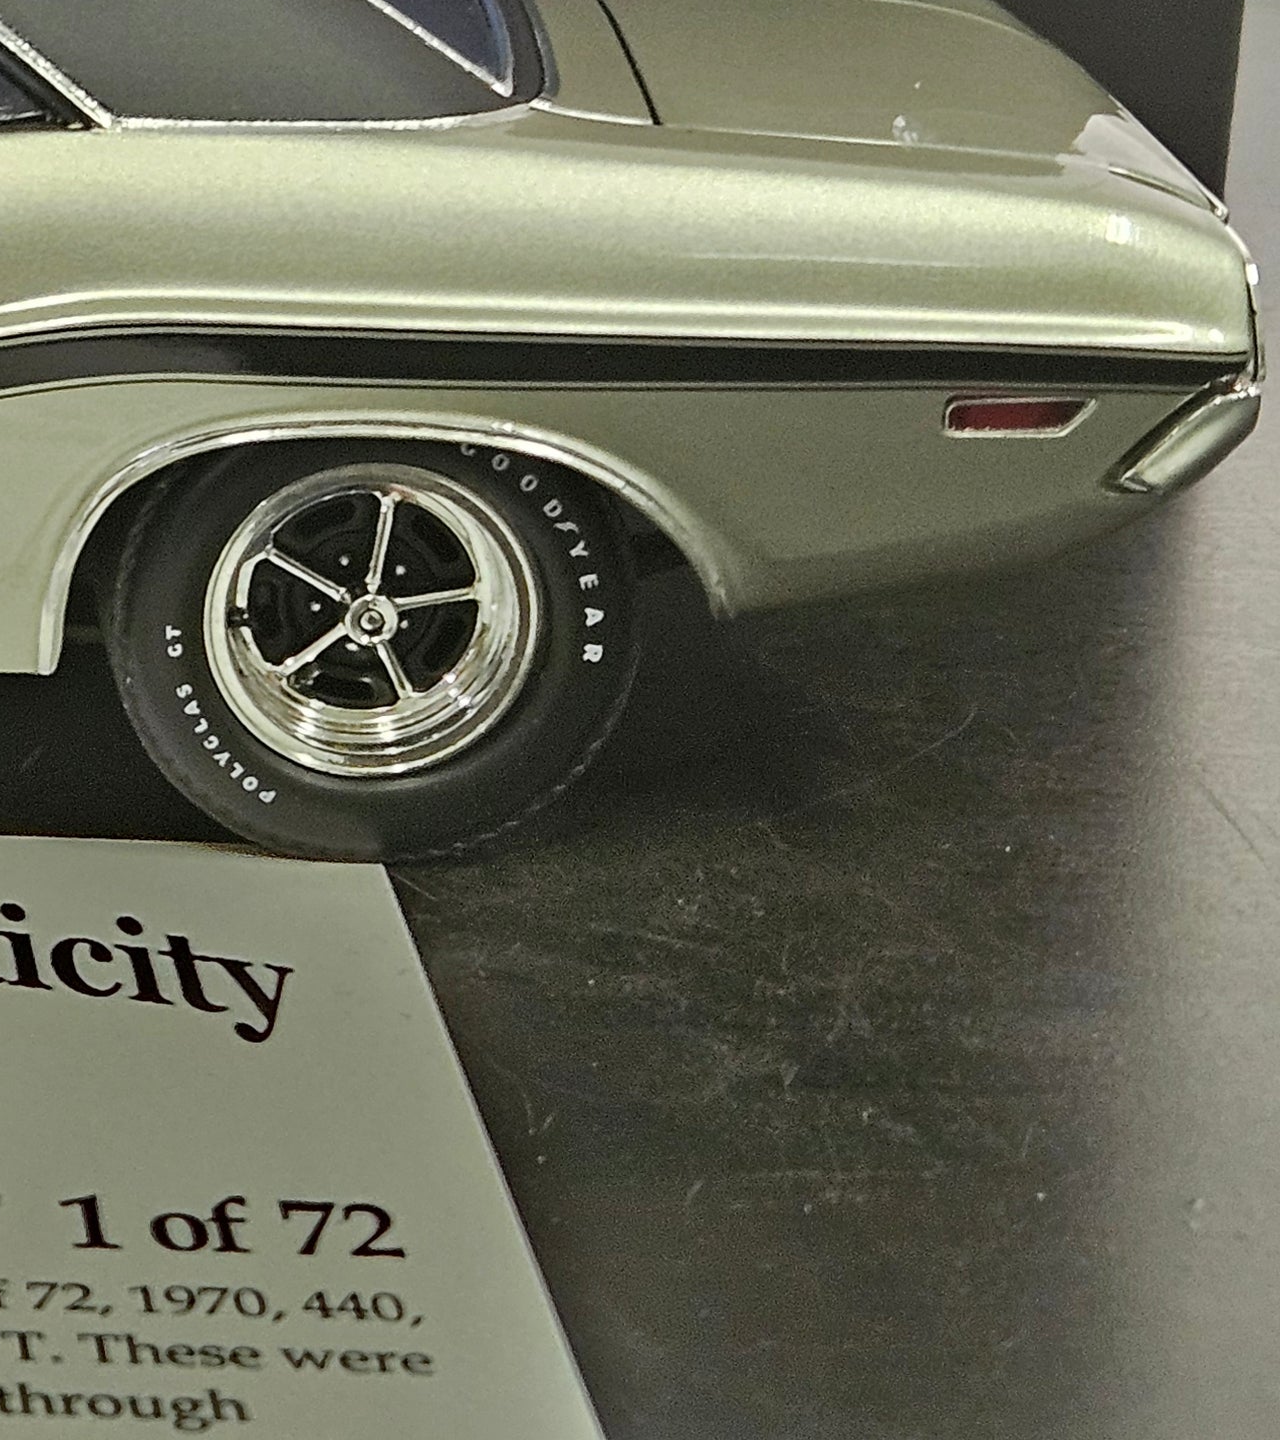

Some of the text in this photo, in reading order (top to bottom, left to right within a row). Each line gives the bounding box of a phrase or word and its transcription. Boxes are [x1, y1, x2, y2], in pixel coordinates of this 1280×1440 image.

[163, 623, 184, 660] GT
[58, 1193, 122, 1250] 1
[149, 1193, 250, 1257] of
[278, 1200, 408, 1260] 72
[24, 1280, 112, 1316] 72,
[124, 1284, 285, 1322] 1970,
[301, 1290, 424, 1328] 440,
[77, 1332, 262, 1370] These
[280, 1346, 435, 1378] were
